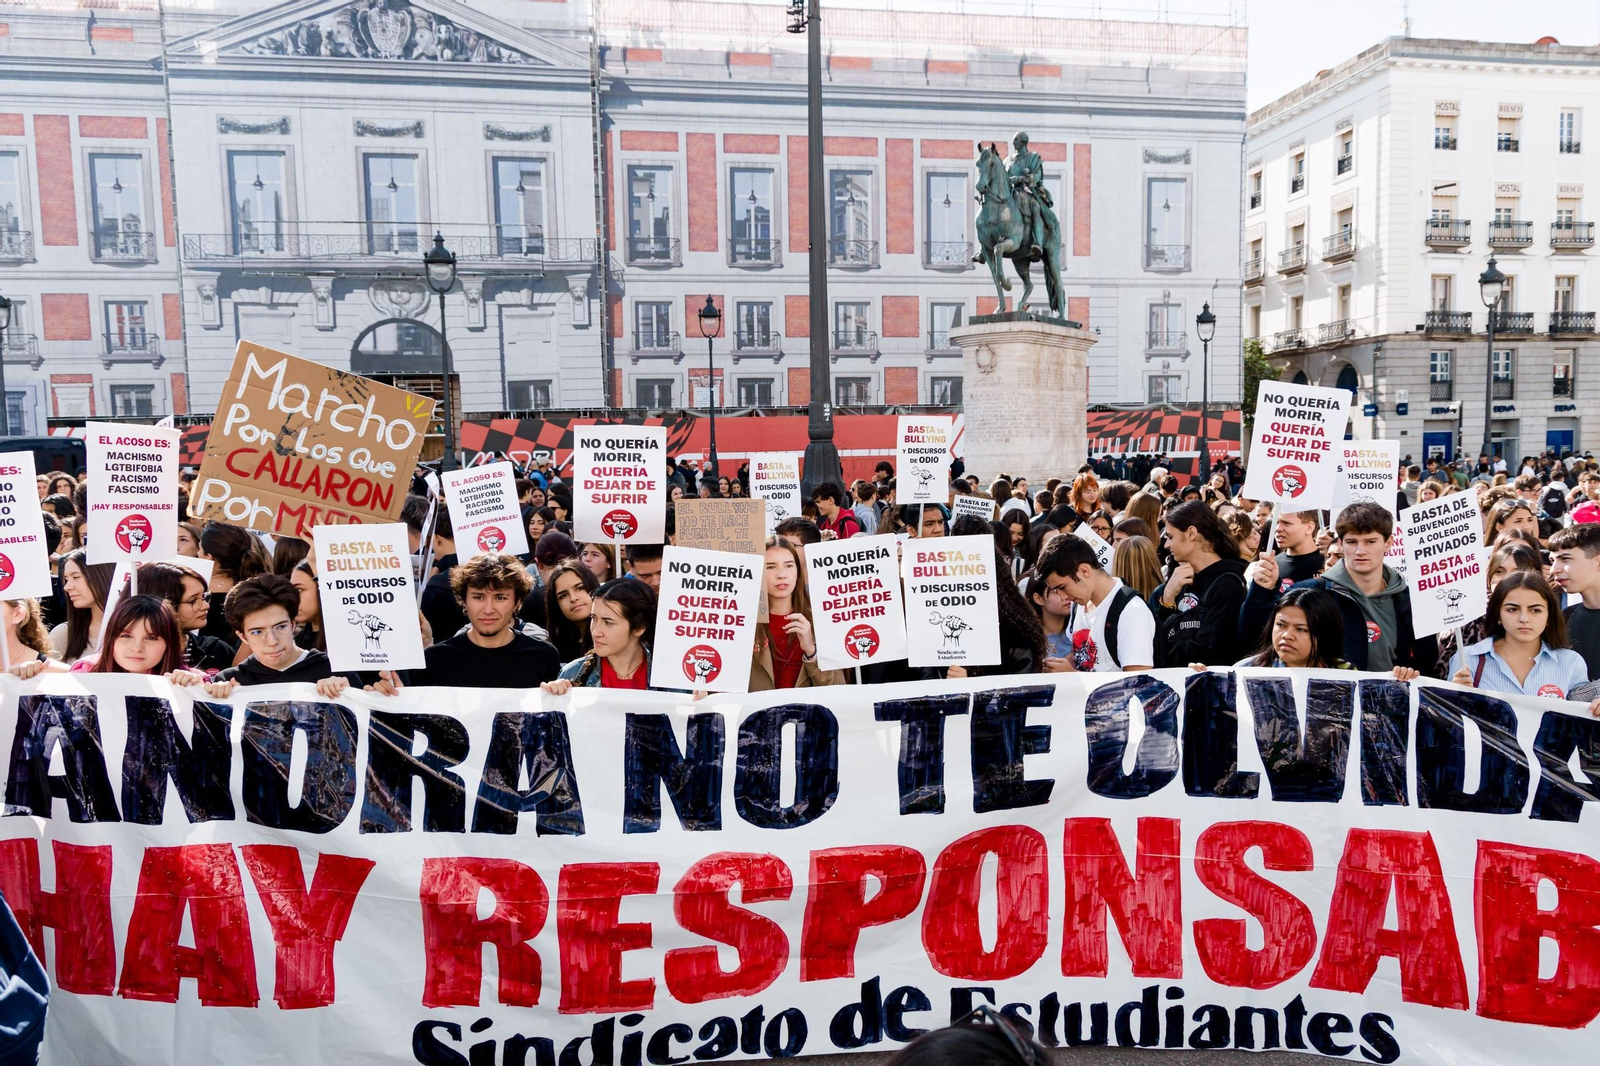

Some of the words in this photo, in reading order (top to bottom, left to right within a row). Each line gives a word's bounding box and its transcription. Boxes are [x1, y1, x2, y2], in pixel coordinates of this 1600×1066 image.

[1436, 102, 1460, 111] HOSTAL
[1497, 184, 1520, 192] HOSTAL
[235, 352, 416, 450] Marcho
[1264, 393, 1284, 404] NO
[1287, 397, 1340, 410] QUERÍA
[1554, 404, 1577, 412] BBVA
[1275, 407, 1325, 424] MORIR,
[1493, 404, 1516, 413] BBVA
[907, 425, 936, 434] BASTA
[1270, 422, 1325, 437] QUERÍA
[98, 435, 113, 445] EL
[116, 436, 152, 447] ACOSO
[154, 439, 171, 448] ES:
[223, 403, 276, 446] Por
[295, 427, 344, 464] Los
[348, 448, 397, 478] Que
[580, 438, 601, 449] NO
[605, 437, 659, 450] QUERÍA
[904, 435, 946, 443] BULLYING
[1261, 434, 1307, 448] DEJAR
[1311, 439, 1331, 451] DE
[107, 452, 162, 462] MACHISMO
[593, 452, 646, 464] MORIR,
[918, 456, 939, 464] ODIO
[1266, 448, 1321, 463] SUFRIR
[1343, 449, 1377, 458] BASTA
[105, 463, 163, 473] LGTBIFOBIA
[591, 464, 648, 478] QUERÍA
[111, 474, 158, 483] RACISMO
[225, 447, 394, 512] CALLARON
[463, 473, 491, 485] ACOSO
[755, 472, 795, 480] BULLYING
[108, 485, 160, 494] FASCISMO
[459, 482, 502, 495] MACHISMO
[583, 480, 632, 490] DEJAR
[636, 480, 656, 490] DE
[1359, 482, 1384, 490] ODIO
[196, 478, 273, 528] Por
[460, 489, 504, 503] LGTBIFOBIA
[591, 493, 648, 504] SUFRIR
[771, 492, 791, 500] ODIO
[92, 503, 110, 511] ¡HAY
[465, 497, 501, 510] RACISMO
[465, 504, 505, 517] FASCISMO
[678, 502, 694, 514] EL
[1412, 503, 1451, 524] BASTA
[1453, 497, 1468, 512] DE
[679, 515, 698, 528] NO
[700, 515, 716, 527] TE
[719, 514, 749, 527] HACE
[1407, 509, 1476, 537] SUBVENCIONES
[735, 528, 749, 539] TE
[1419, 536, 1425, 545] A
[1427, 523, 1470, 543] COLEGIOS
[329, 541, 376, 555] BASTA
[380, 544, 394, 553] DE
[1414, 532, 1477, 560] PRIVADOS
[326, 556, 401, 572] BULLYING
[812, 556, 833, 568] NO
[837, 546, 890, 565] QUERÍA
[917, 551, 964, 563] BASTA
[968, 553, 981, 561] DE
[668, 561, 691, 573] NO
[695, 565, 753, 579] QUERÍA
[913, 564, 986, 577] BULLYING
[1420, 555, 1463, 576] BASTA
[1465, 553, 1475, 563] DE
[827, 564, 879, 580] MORIR,
[1417, 563, 1480, 591] BULLYING
[326, 582, 333, 590] Y
[336, 577, 407, 589] DISCURSOS
[681, 578, 738, 595] MORIR,
[827, 576, 883, 597] QUERÍA
[920, 582, 990, 593] DISCURSOS
[342, 597, 356, 605] DE
[357, 591, 394, 604] ODIO
[677, 595, 738, 610] QUERÍA
[822, 594, 868, 611] DEJAR
[872, 591, 892, 603] DE
[925, 599, 938, 607] DE
[940, 595, 976, 607] ODIO
[668, 609, 720, 624] DEJAR
[724, 614, 745, 626] DE
[831, 606, 885, 623] SUFRIR
[674, 625, 735, 640] SUFRIR
[622, 703, 839, 834] NO
[873, 683, 1057, 815] TE
[0, 838, 376, 1010] HAY
[412, 1004, 808, 1066] Sindicato
[830, 975, 932, 1049] de
